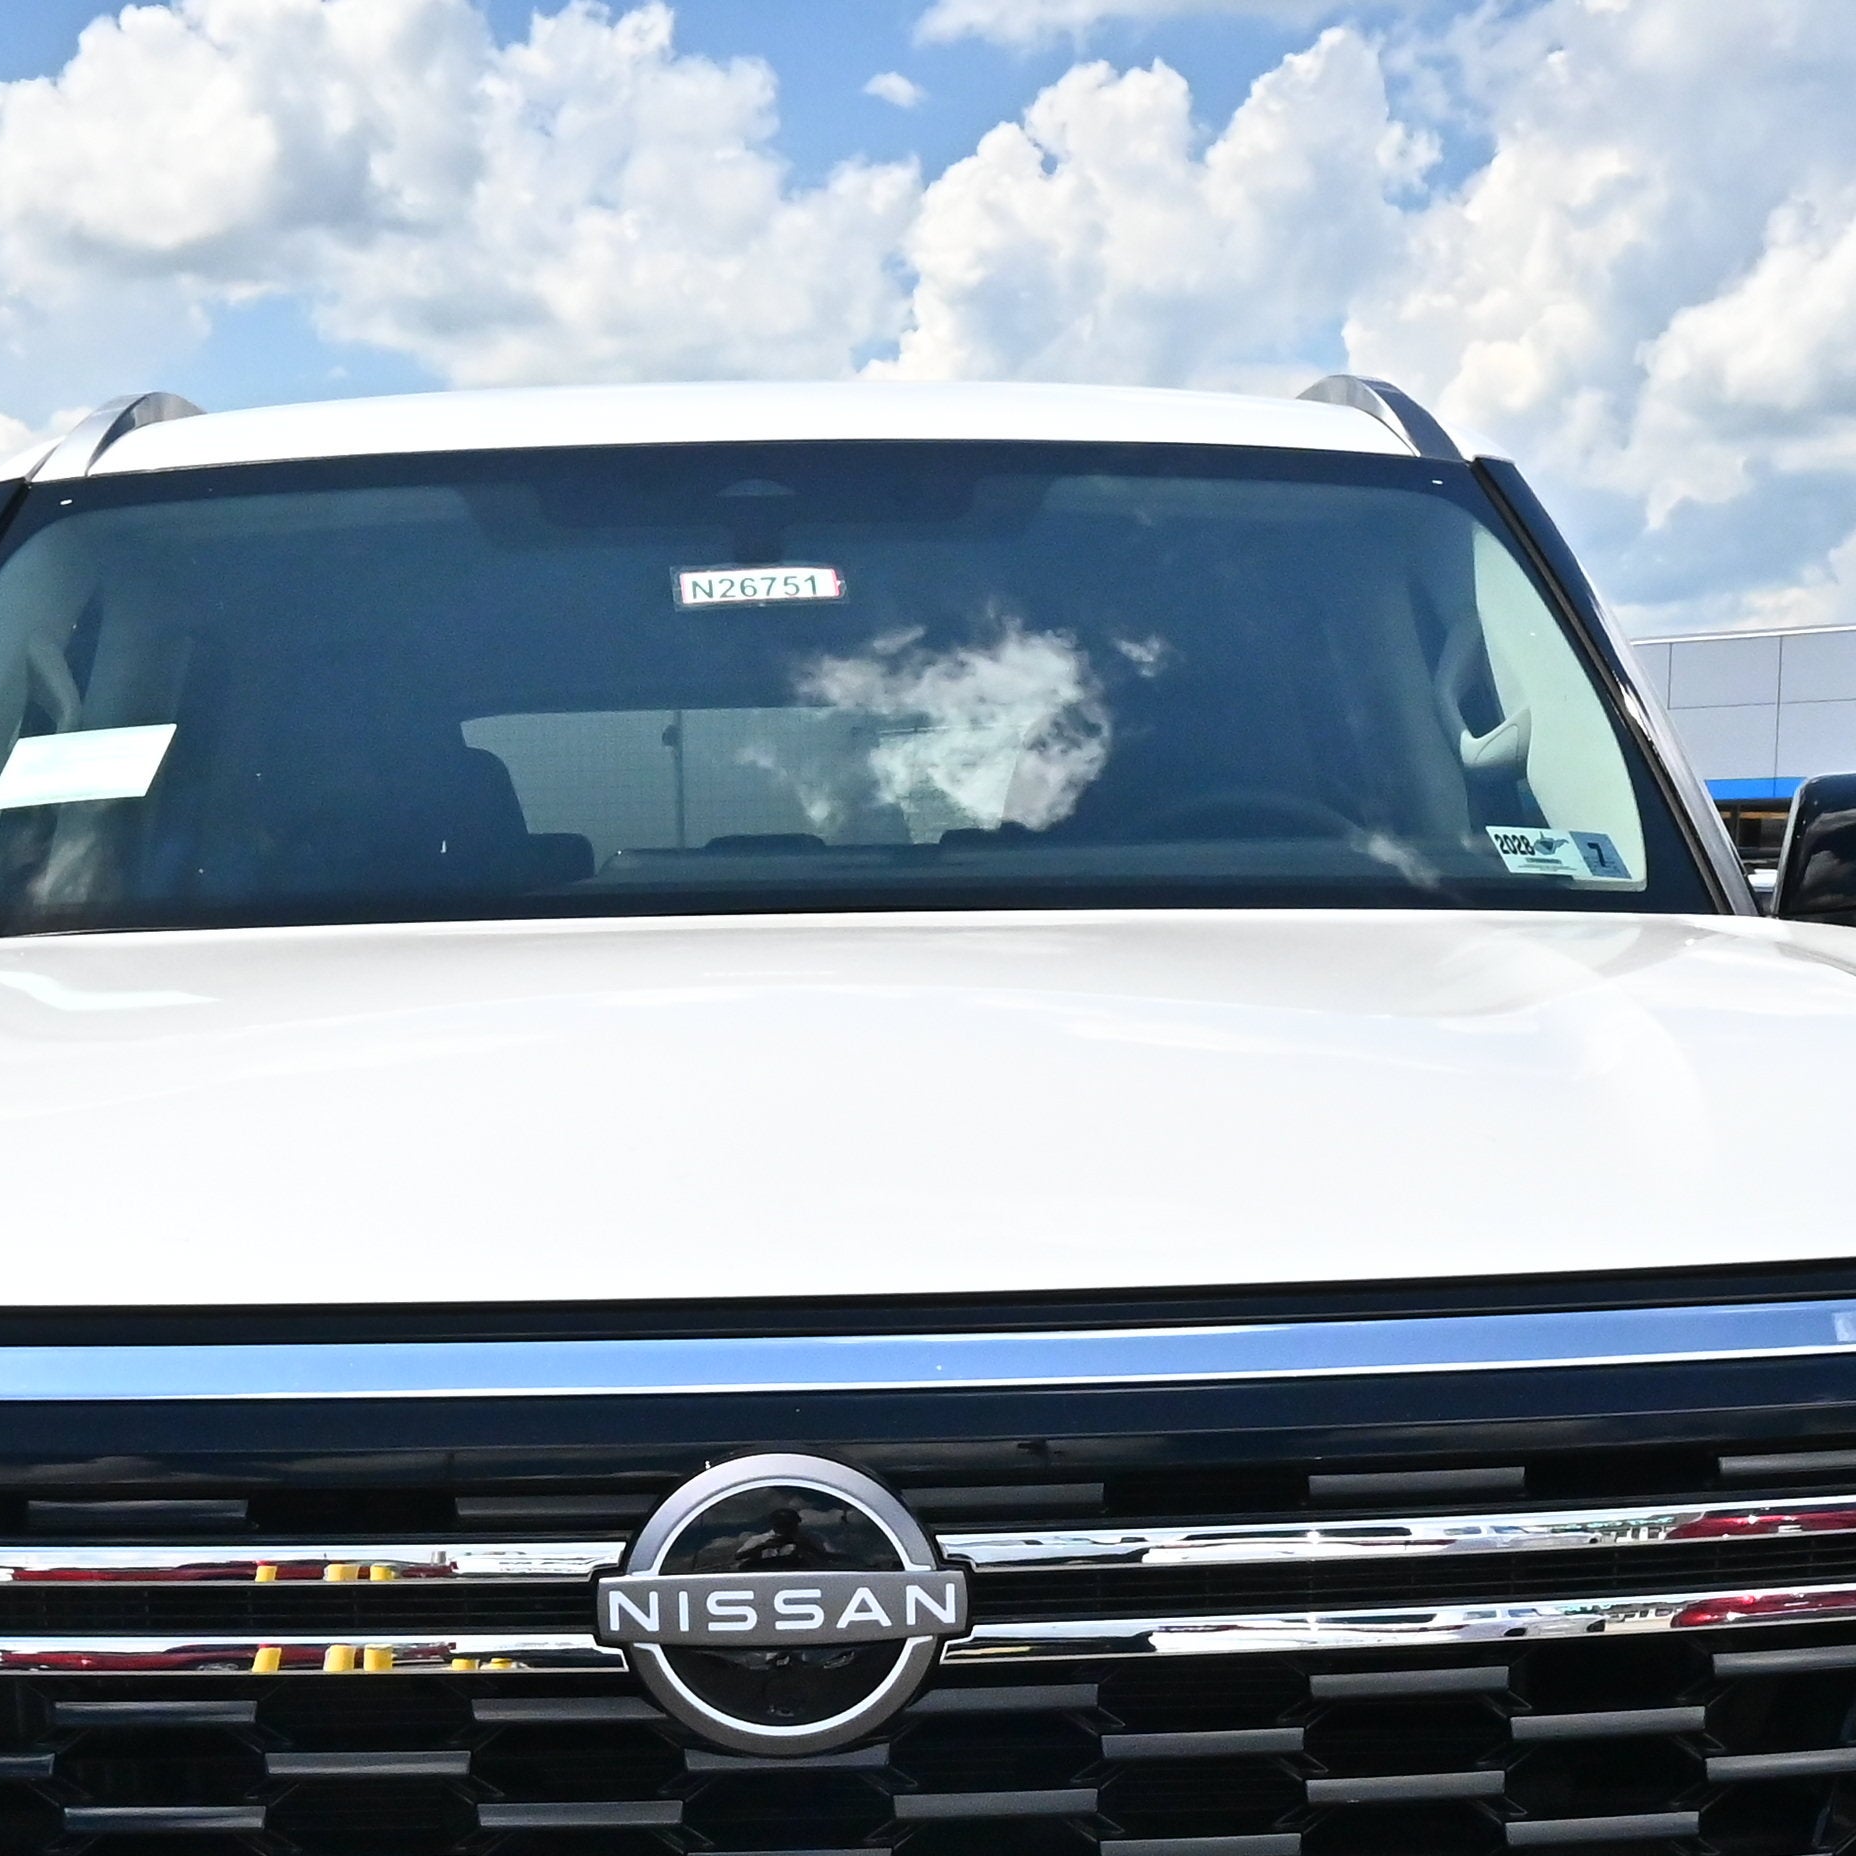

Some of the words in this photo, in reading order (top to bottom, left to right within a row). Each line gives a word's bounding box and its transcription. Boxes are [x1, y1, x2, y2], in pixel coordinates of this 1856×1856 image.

[691, 574, 818, 600] N26751
[1493, 833, 1536, 856] 2028
[608, 1582, 957, 1633] NISSAN
